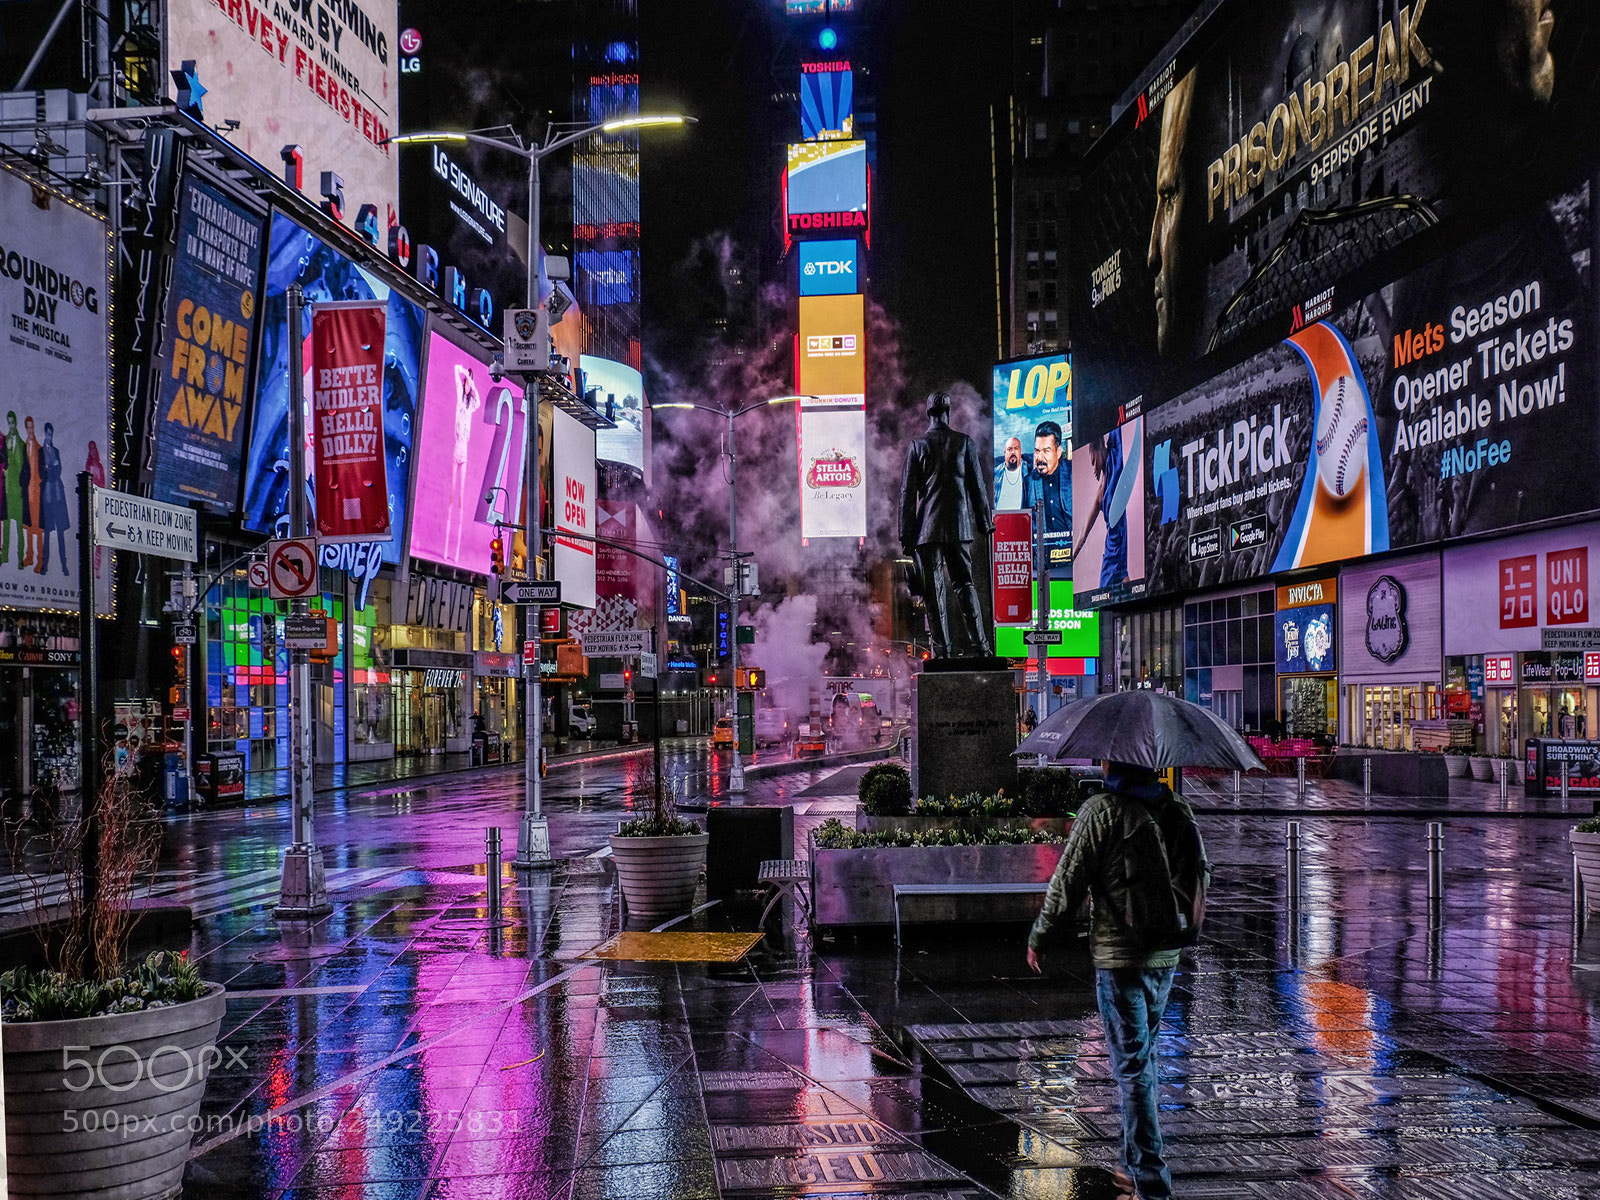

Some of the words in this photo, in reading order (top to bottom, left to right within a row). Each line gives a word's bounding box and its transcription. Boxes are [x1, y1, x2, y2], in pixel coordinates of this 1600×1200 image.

[318, 3, 343, 53] BY
[273, 2, 315, 51] AWARD
[320, 47, 360, 95] WINNER
[401, 58, 420, 73] LG
[802, 61, 851, 73] TOSHIBA
[213, 0, 289, 64] ARVEY
[295, 45, 389, 155] FIERSTEIN
[1148, 58, 1177, 96] MARRIOTT
[1148, 77, 1174, 111] MARQUIS
[1311, 118, 1378, 185] 9-EPISODE
[1382, 77, 1433, 134] EVENT
[433, 144, 448, 180] LG
[450, 161, 505, 233] SIGNATURE
[789, 211, 866, 229] TOSHIBA
[197, 217, 239, 257] TRANSPORTS
[239, 244, 249, 264] US
[187, 234, 197, 257] ON
[197, 245, 203, 261] A
[205, 244, 224, 272] WAVE
[225, 256, 235, 277] OF
[815, 260, 853, 275] TDK
[1092, 248, 1121, 288] TONIGHT
[0, 246, 98, 315] ROUNDHOG
[1102, 271, 1115, 301] FOX
[1116, 267, 1121, 289] 5
[24, 286, 58, 325] DAY
[1304, 286, 1335, 310] MARRIOTT
[1304, 301, 1332, 323] MARQUIS
[12, 314, 29, 332] THE
[32, 322, 70, 348] MUSICAL
[177, 299, 248, 365] COME
[1394, 321, 1445, 369] Mets
[1450, 280, 1541, 344] Season
[516, 342, 537, 350] SECURITY
[172, 338, 244, 406] FROM
[517, 358, 536, 366] CAMERA
[1394, 356, 1473, 414] Opener
[1477, 316, 1574, 380] Tickets
[320, 364, 377, 389] BETTE
[1006, 361, 1072, 410] LOP
[315, 386, 380, 411] MIDLER
[1126, 395, 1143, 409] MARRIOTT
[1394, 394, 1492, 456] Available
[1499, 362, 1566, 422] Now!
[167, 384, 242, 442] AWAY
[1126, 403, 1141, 418] MARQUIS
[321, 411, 378, 436] HELLO,
[321, 434, 377, 458] DOLLY!
[1182, 403, 1292, 499] TickPick
[816, 464, 851, 473] STELLA
[1441, 438, 1512, 479] #NoFee
[816, 472, 852, 482] ARTOIS
[566, 475, 585, 504] NOW
[825, 491, 853, 502] Legacy
[1187, 505, 1203, 519] Where
[1204, 499, 1219, 515] smart
[1220, 497, 1232, 509] fans
[1232, 493, 1243, 506] buy
[1244, 486, 1256, 502] and
[1256, 482, 1268, 498] sell
[1268, 476, 1292, 494] tickets.
[104, 497, 152, 523] PEDESTRIAN
[153, 510, 173, 528] FLOW
[174, 513, 193, 532] ZONE
[565, 500, 586, 529] OPEN
[146, 531, 164, 547] KEEP
[166, 534, 193, 553] MOVING
[996, 541, 1029, 552] BETTE
[1240, 530, 1255, 544] Google
[1255, 528, 1266, 541] Play
[994, 551, 1031, 562] MIDLER
[1198, 544, 1207, 557] App
[1206, 542, 1218, 554] Store
[997, 563, 1030, 575] HELLO,
[997, 574, 1029, 585] DOLLY!
[1551, 557, 1580, 585] UNI
[23, 584, 36, 593] ON
[41, 586, 80, 598] BROADWA
[518, 588, 537, 598] ONE
[538, 588, 555, 598] WAY
[1288, 583, 1323, 605] INVICTA
[406, 573, 474, 632] FOREVER
[1063, 609, 1094, 618] STORE
[1551, 588, 1584, 620] QLO
[302, 625, 321, 633] Square
[1053, 620, 1081, 629] SOON
[1544, 630, 1577, 639] PEDESTRIAN
[1577, 630, 1592, 638] FLOW
[584, 633, 615, 643] PEDESTRIAN
[615, 633, 630, 642] FLOW
[630, 633, 643, 642] ZONE
[584, 644, 597, 653] KEEP
[598, 644, 617, 653] MOVING
[1544, 640, 1557, 648] KEEP
[1558, 640, 1579, 648] MOVING
[18, 651, 43, 661] Canon
[48, 652, 72, 661] SONY
[1500, 660, 1510, 669] UNI
[424, 669, 453, 688] FOREVER
[1500, 669, 1511, 680] QLO
[1521, 663, 1552, 677] LifeWear
[1555, 662, 1584, 680] Pop-Up
[1546, 745, 1598, 754] BROADWAY'S
[1569, 753, 1595, 761] THING
[1546, 776, 1600, 788] CHCAG
